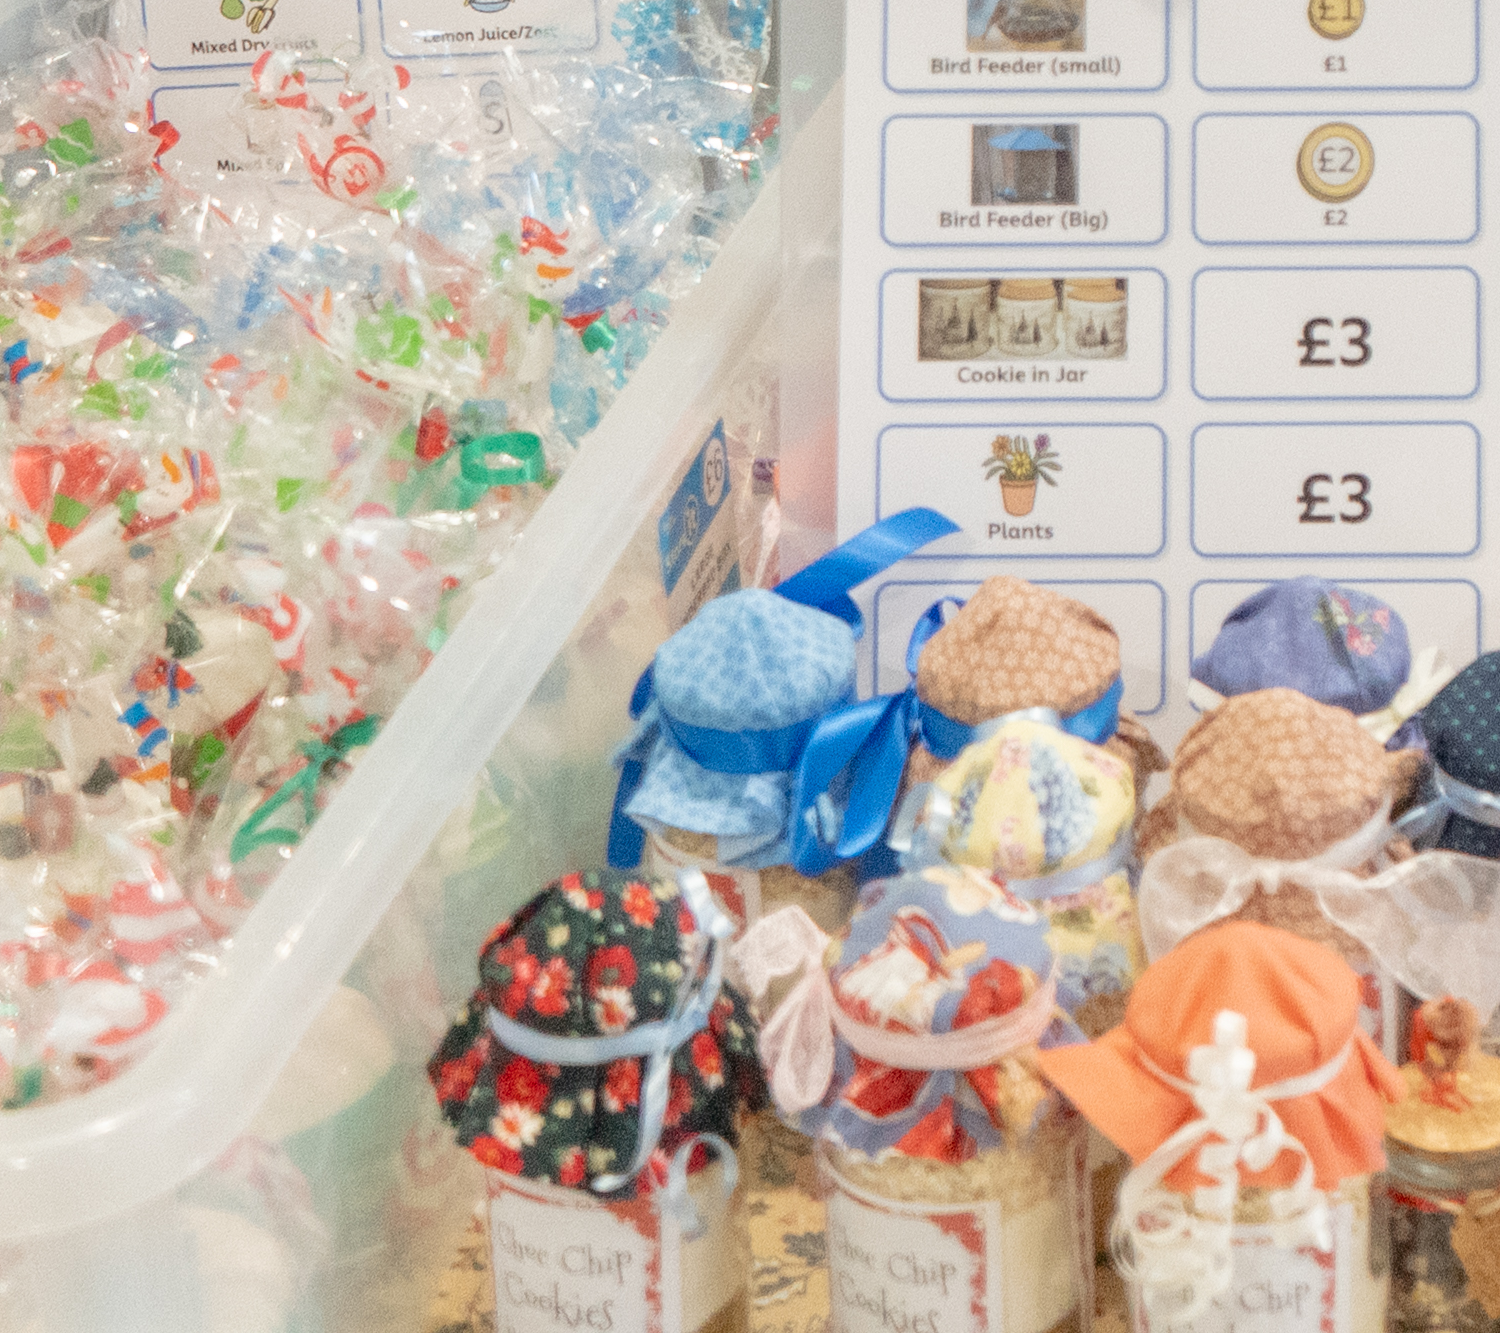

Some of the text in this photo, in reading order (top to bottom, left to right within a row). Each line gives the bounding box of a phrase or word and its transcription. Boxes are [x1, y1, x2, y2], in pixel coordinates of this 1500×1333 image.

[191, 39, 237, 54] Mixed
[930, 56, 1122, 77] Bird Feeder (small)
[1323, 55, 1348, 74] £1
[1318, 145, 1357, 174] £2
[939, 210, 1109, 232] Bird Feeder (Big)
[1323, 208, 1349, 227] £2
[1297, 316, 1374, 368] £3
[957, 366, 1089, 385] Cookie in Jar
[1297, 472, 1374, 525] £3
[987, 521, 1055, 541] Plants
[559, 1243, 633, 1286] Chip
[888, 1251, 957, 1296] Chip
[504, 1270, 615, 1331] Cookies
[1239, 1282, 1310, 1318] Chip
